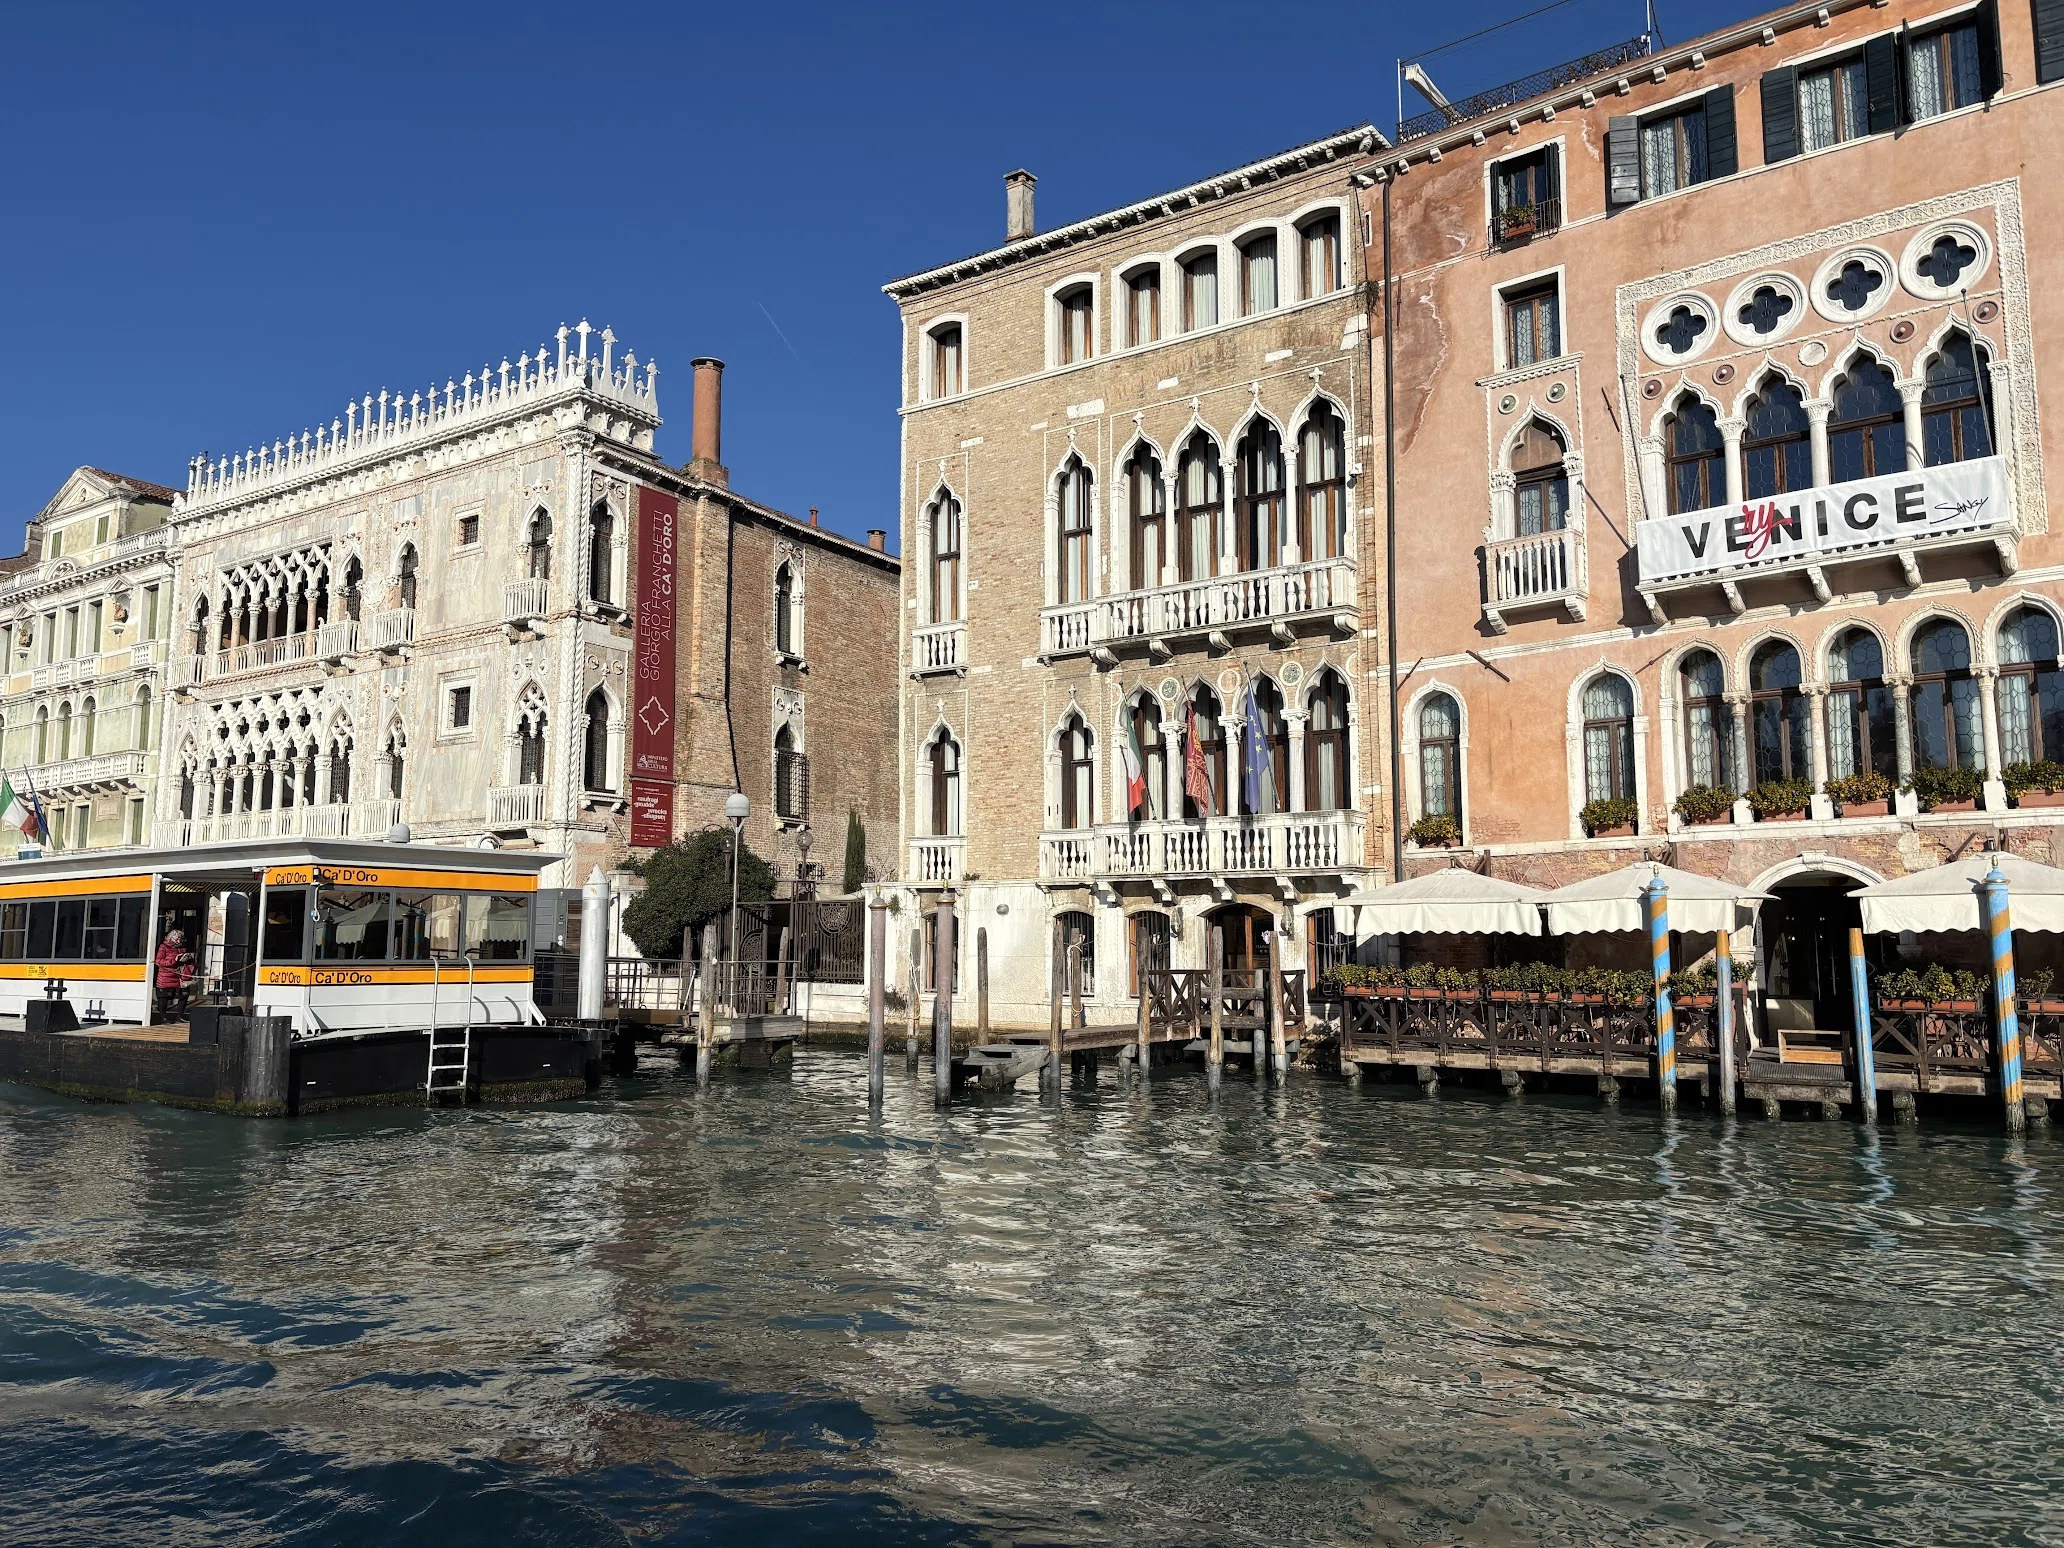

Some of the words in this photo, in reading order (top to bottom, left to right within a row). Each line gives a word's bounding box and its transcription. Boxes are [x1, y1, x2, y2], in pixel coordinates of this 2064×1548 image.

[651, 510, 663, 609] FRANCHETTI
[662, 513, 673, 566] D'ORO
[640, 601, 651, 679] GALLERIA
[661, 599, 671, 641] ALLA
[650, 614, 661, 681] GIORGIO
[322, 868, 341, 881] Ca'
[343, 869, 379, 882] D'Oro
[315, 971, 335, 984] Ca'
[336, 971, 372, 984] D'Oro
